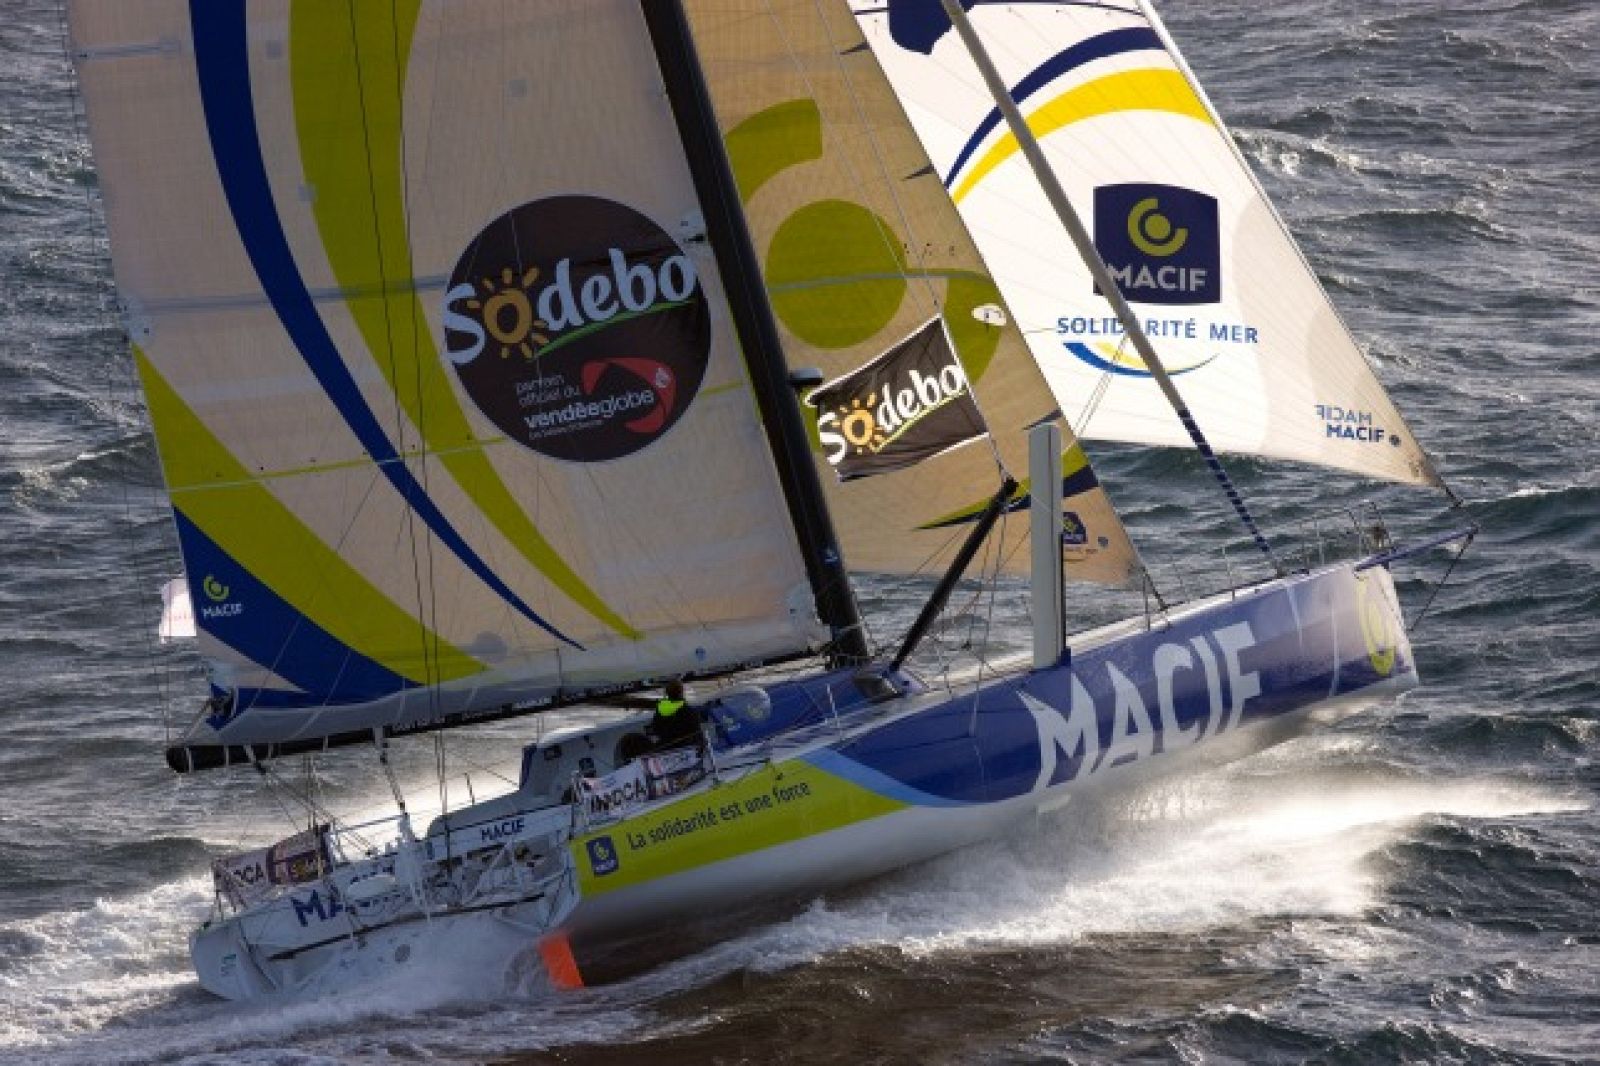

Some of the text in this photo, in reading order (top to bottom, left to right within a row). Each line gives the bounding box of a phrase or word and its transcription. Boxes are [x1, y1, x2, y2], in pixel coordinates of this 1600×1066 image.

[1104, 263, 1208, 292] MACIF
[1057, 317, 1258, 344] SOLIDRITÉ MER
[818, 363, 968, 465] Sodebo
[1326, 424, 1384, 442] MACIF
[1017, 620, 1261, 796] MACIF
[481, 819, 525, 841] MACIF
[626, 782, 811, 850] La solidarité est une force
